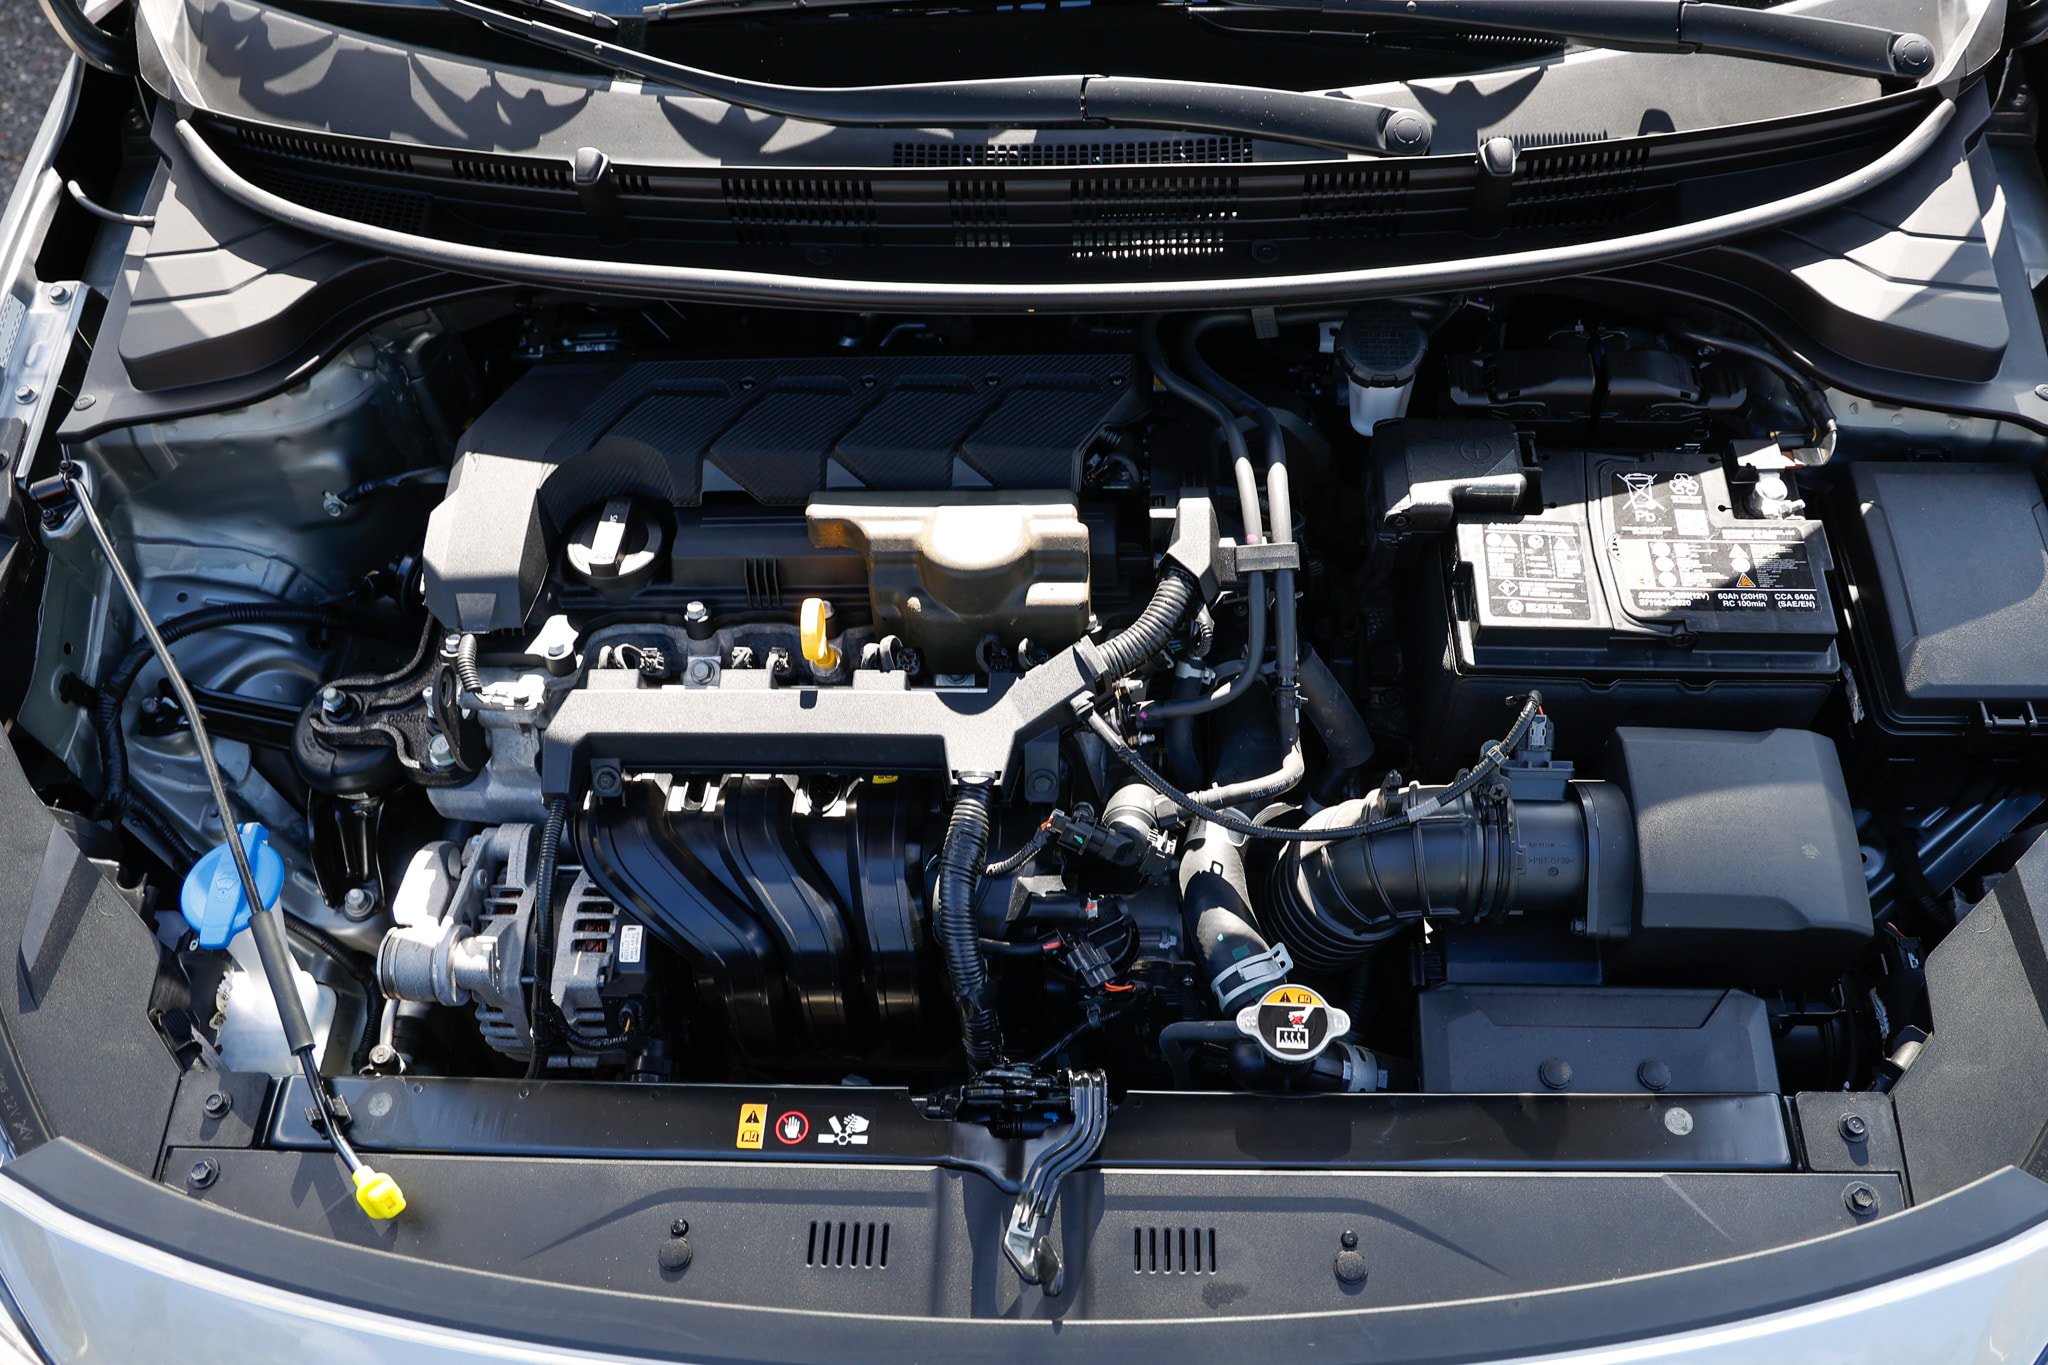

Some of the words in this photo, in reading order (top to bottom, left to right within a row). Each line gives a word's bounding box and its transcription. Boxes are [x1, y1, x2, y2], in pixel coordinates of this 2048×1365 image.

[1717, 592, 1739, 600] 60Ah
[1740, 592, 1768, 602] (20HR)
[1774, 593, 1794, 601] CCA
[1777, 600, 1816, 609] (SAE/EN)
